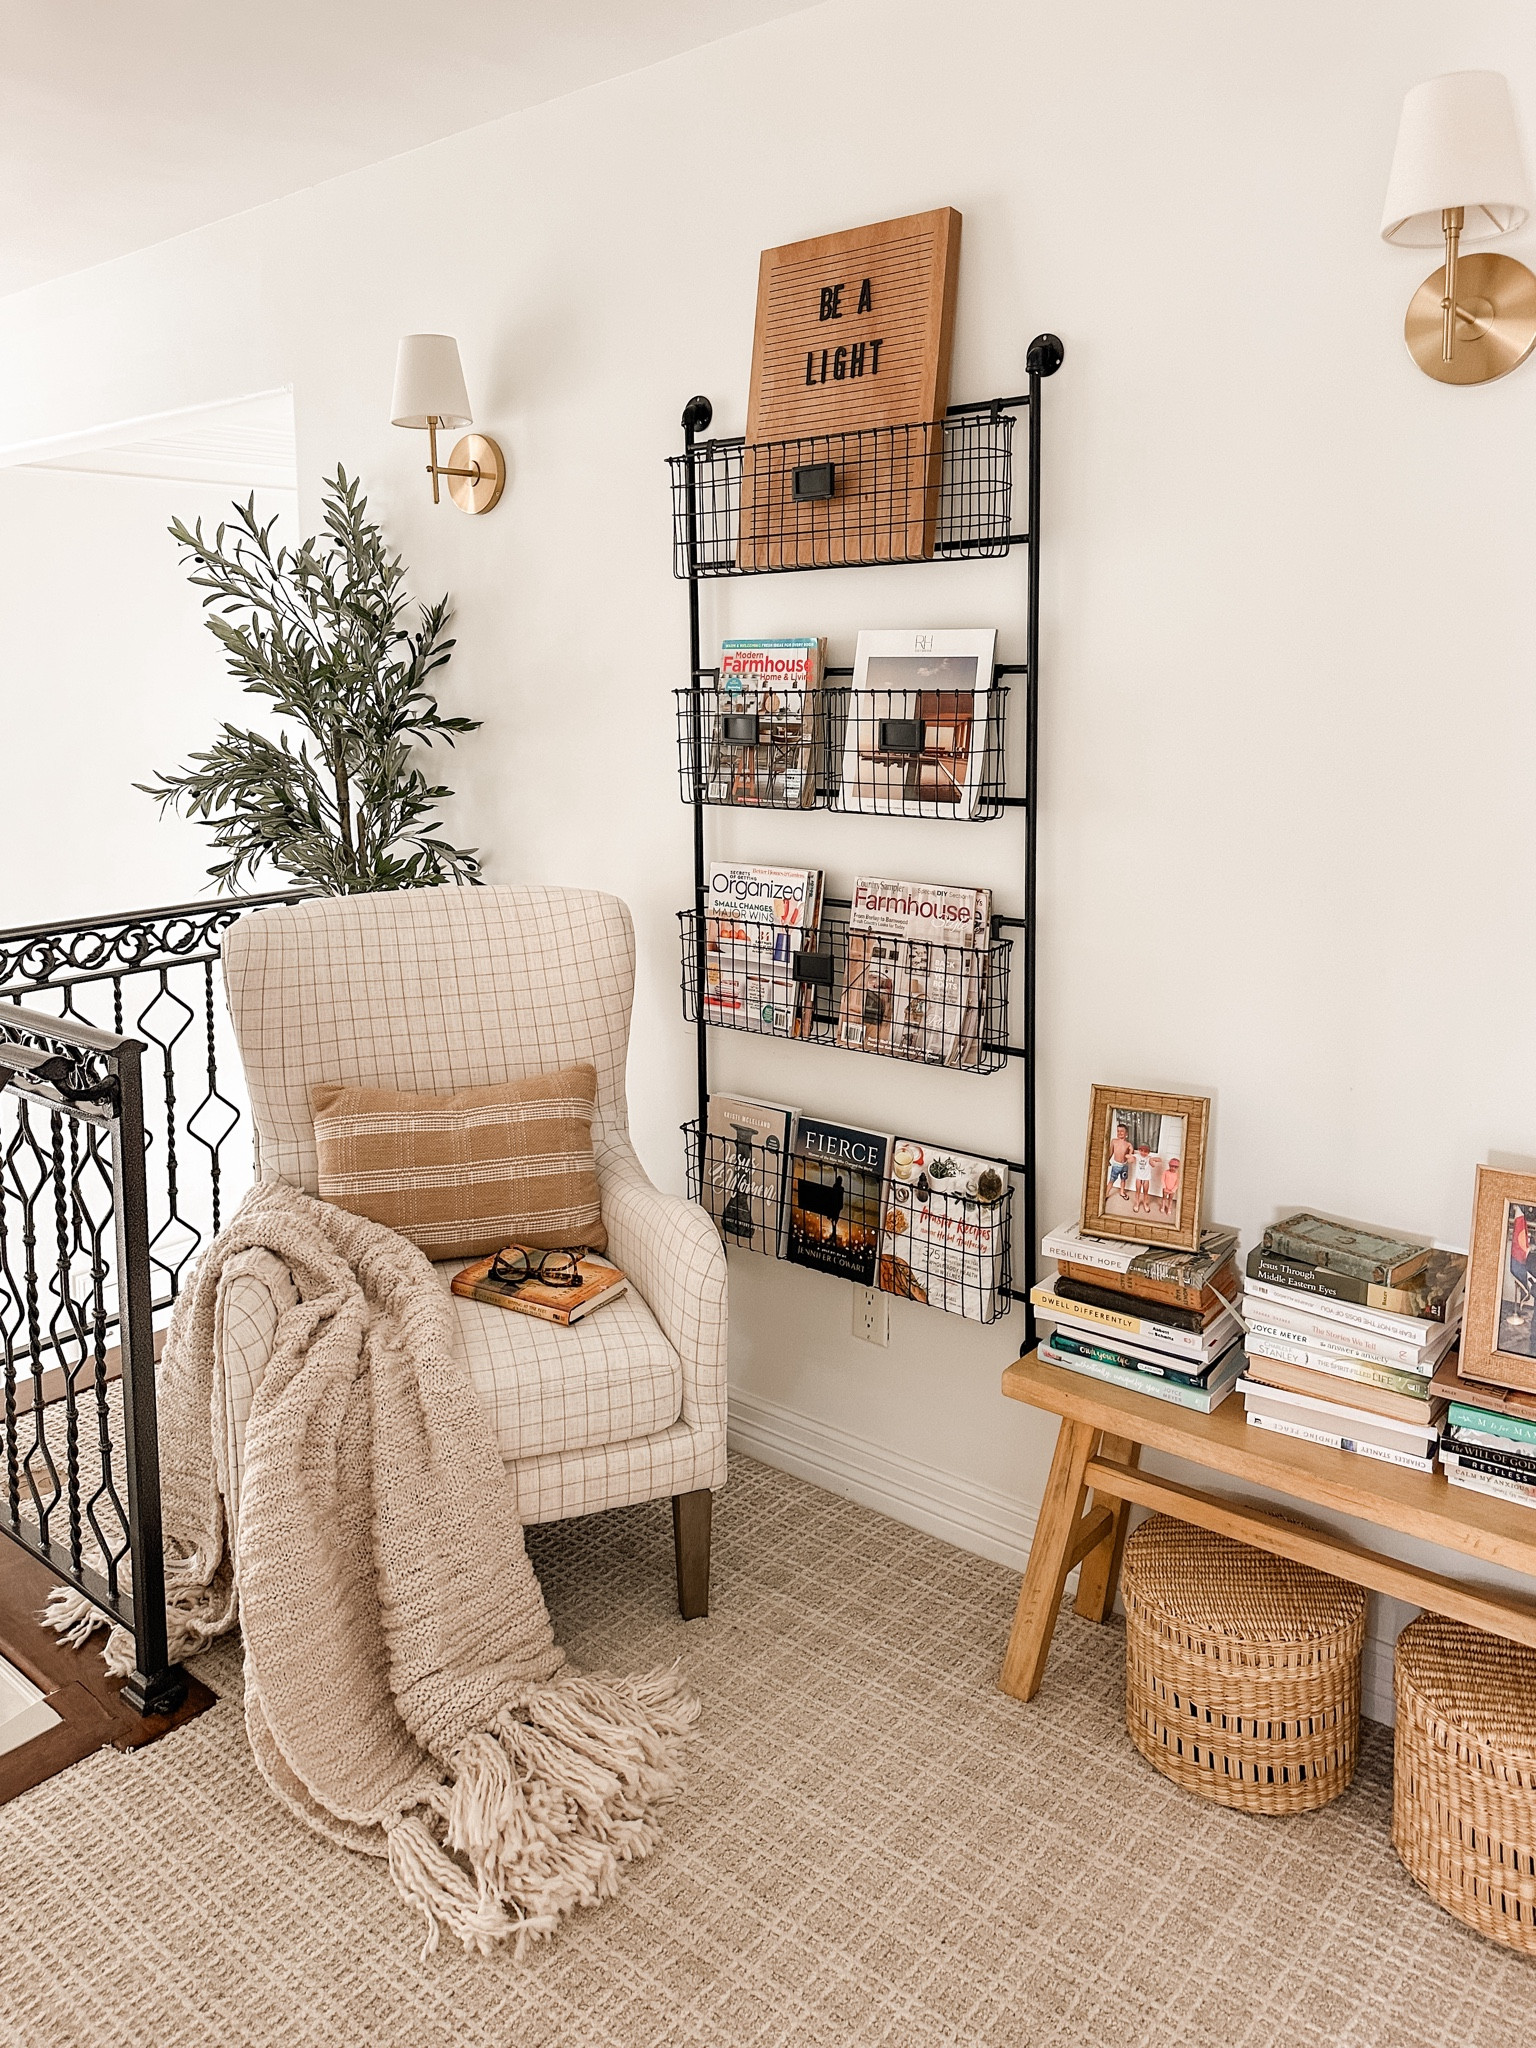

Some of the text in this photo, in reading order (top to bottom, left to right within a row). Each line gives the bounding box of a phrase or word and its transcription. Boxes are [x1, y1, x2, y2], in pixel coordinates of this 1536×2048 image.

[819, 278, 872, 322] BE A
[805, 338, 884, 386] LIGHT
[915, 634, 934, 650] RH
[723, 656, 814, 673] Farmhouse
[736, 651, 764, 660] Modern
[760, 673, 782, 681] Home
[783, 673, 789, 681] &
[712, 873, 805, 902] Organized
[856, 878, 905, 894] Country Sampler
[714, 899, 773, 913] SMALL CHANGES
[855, 886, 970, 923] Farmhouse
[712, 907, 775, 923] MAJOR WINS
[886, 917, 909, 925] Barnwood
[934, 959, 955, 969] BACK
[724, 1111, 741, 1122] KRISTI
[805, 1131, 879, 1167] FIERCE
[956, 1216, 991, 1241] Recipes
[797, 1245, 832, 1263] JENNIFER
[922, 1245, 941, 1260] 375
[1049, 1246, 1122, 1269] RESILIENT HOPE
[1258, 1259, 1316, 1281] Jesus Through
[1258, 1270, 1337, 1296] Middle Eastern Eyes
[1041, 1295, 1134, 1328] DWELL DIFFERENTLY
[1320, 1306, 1417, 1340] FEAR IS NOT THE BOSS OF YOU
[1154, 1332, 1175, 1342] Schmitz
[1252, 1323, 1308, 1344] JOYCE MEYER
[1312, 1325, 1377, 1351] The Stories We Tell
[1258, 1344, 1299, 1364] STANLEY
[1263, 1340, 1287, 1352] CHARLES
[1326, 1342, 1353, 1356] answer
[1360, 1351, 1389, 1368] anxiety
[1096, 1350, 1117, 1363] your
[1317, 1359, 1330, 1368] THE
[1371, 1369, 1393, 1386] LIFE
[1145, 1383, 1161, 1394] you
[1162, 1393, 1182, 1404] MEYER
[1163, 1386, 1182, 1397] JOYCE
[1272, 1422, 1338, 1447] FINDING PEACE
[1477, 1418, 1487, 1428] M
[1497, 1423, 1510, 1433] for
[1360, 1445, 1426, 1469] CHARLES STANLEY
[1451, 1444, 1536, 1471] The WILL OF GOD
[1455, 1468, 1477, 1480] CALM
[1479, 1474, 1492, 1483] MY
[1493, 1479, 1530, 1493] ANXIOUS
[1471, 1461, 1529, 1483] RESTLESS
